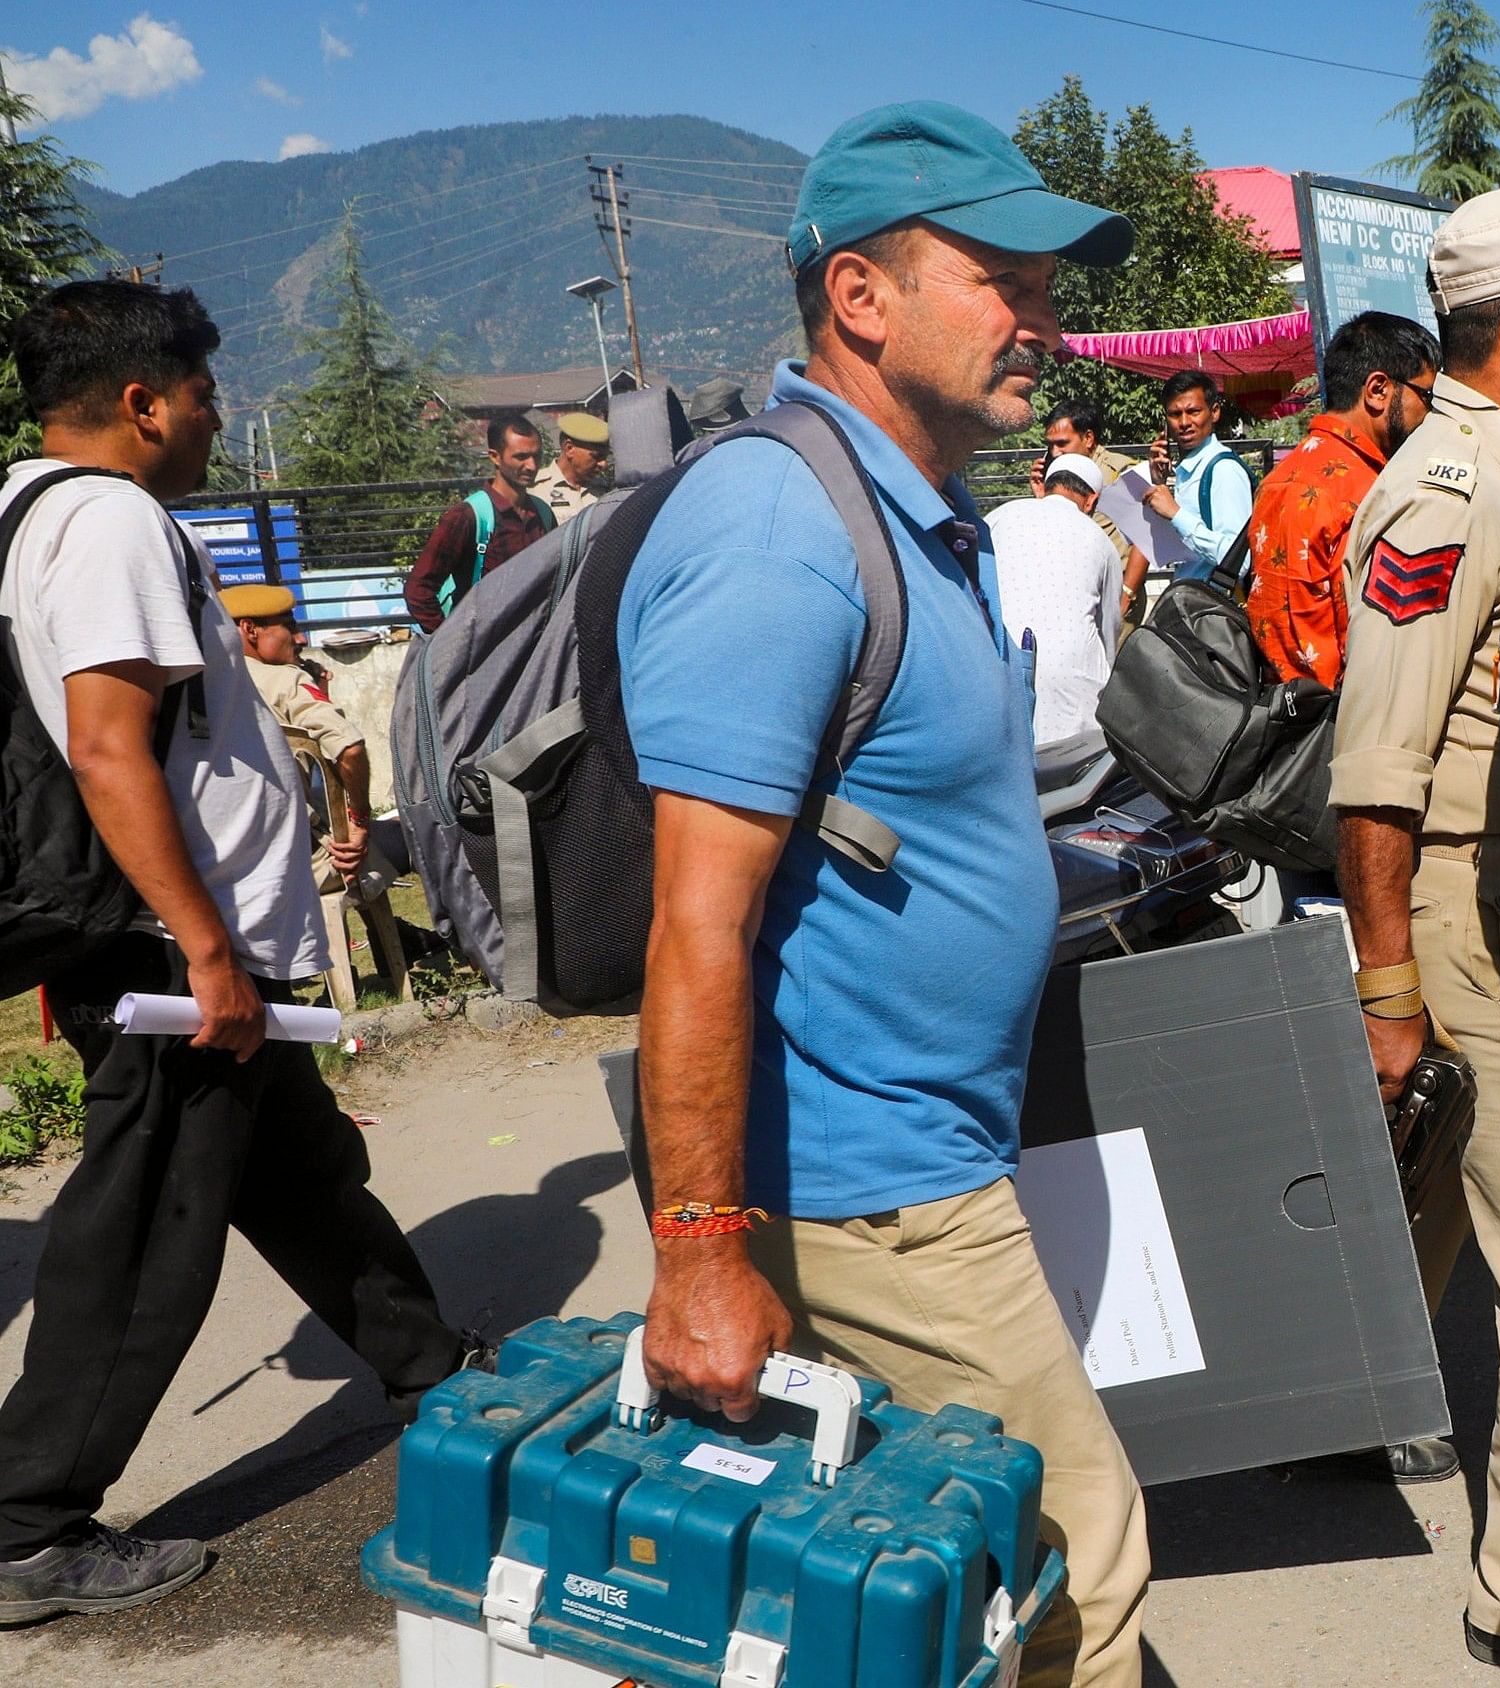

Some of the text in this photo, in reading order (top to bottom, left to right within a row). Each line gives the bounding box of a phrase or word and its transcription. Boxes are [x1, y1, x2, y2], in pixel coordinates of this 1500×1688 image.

[1317, 192, 1433, 235] ACCOMMODATION
[1318, 218, 1433, 259] NEW DC OFFIC
[1362, 253, 1389, 273] BLOCK
[1391, 258, 1405, 273] NO
[1428, 465, 1467, 481] JKP
[1147, 1271, 1157, 1286] and
[1157, 1303, 1169, 1330] Station
[1129, 1348, 1139, 1366] Date
[1165, 1331, 1176, 1360] Polling
[784, 1368, 810, 1394] P
[714, 1458, 752, 1474] PS-35
[562, 1598, 708, 1648] ELECTRONICS CORPORATION OF INDIA LIMITED
